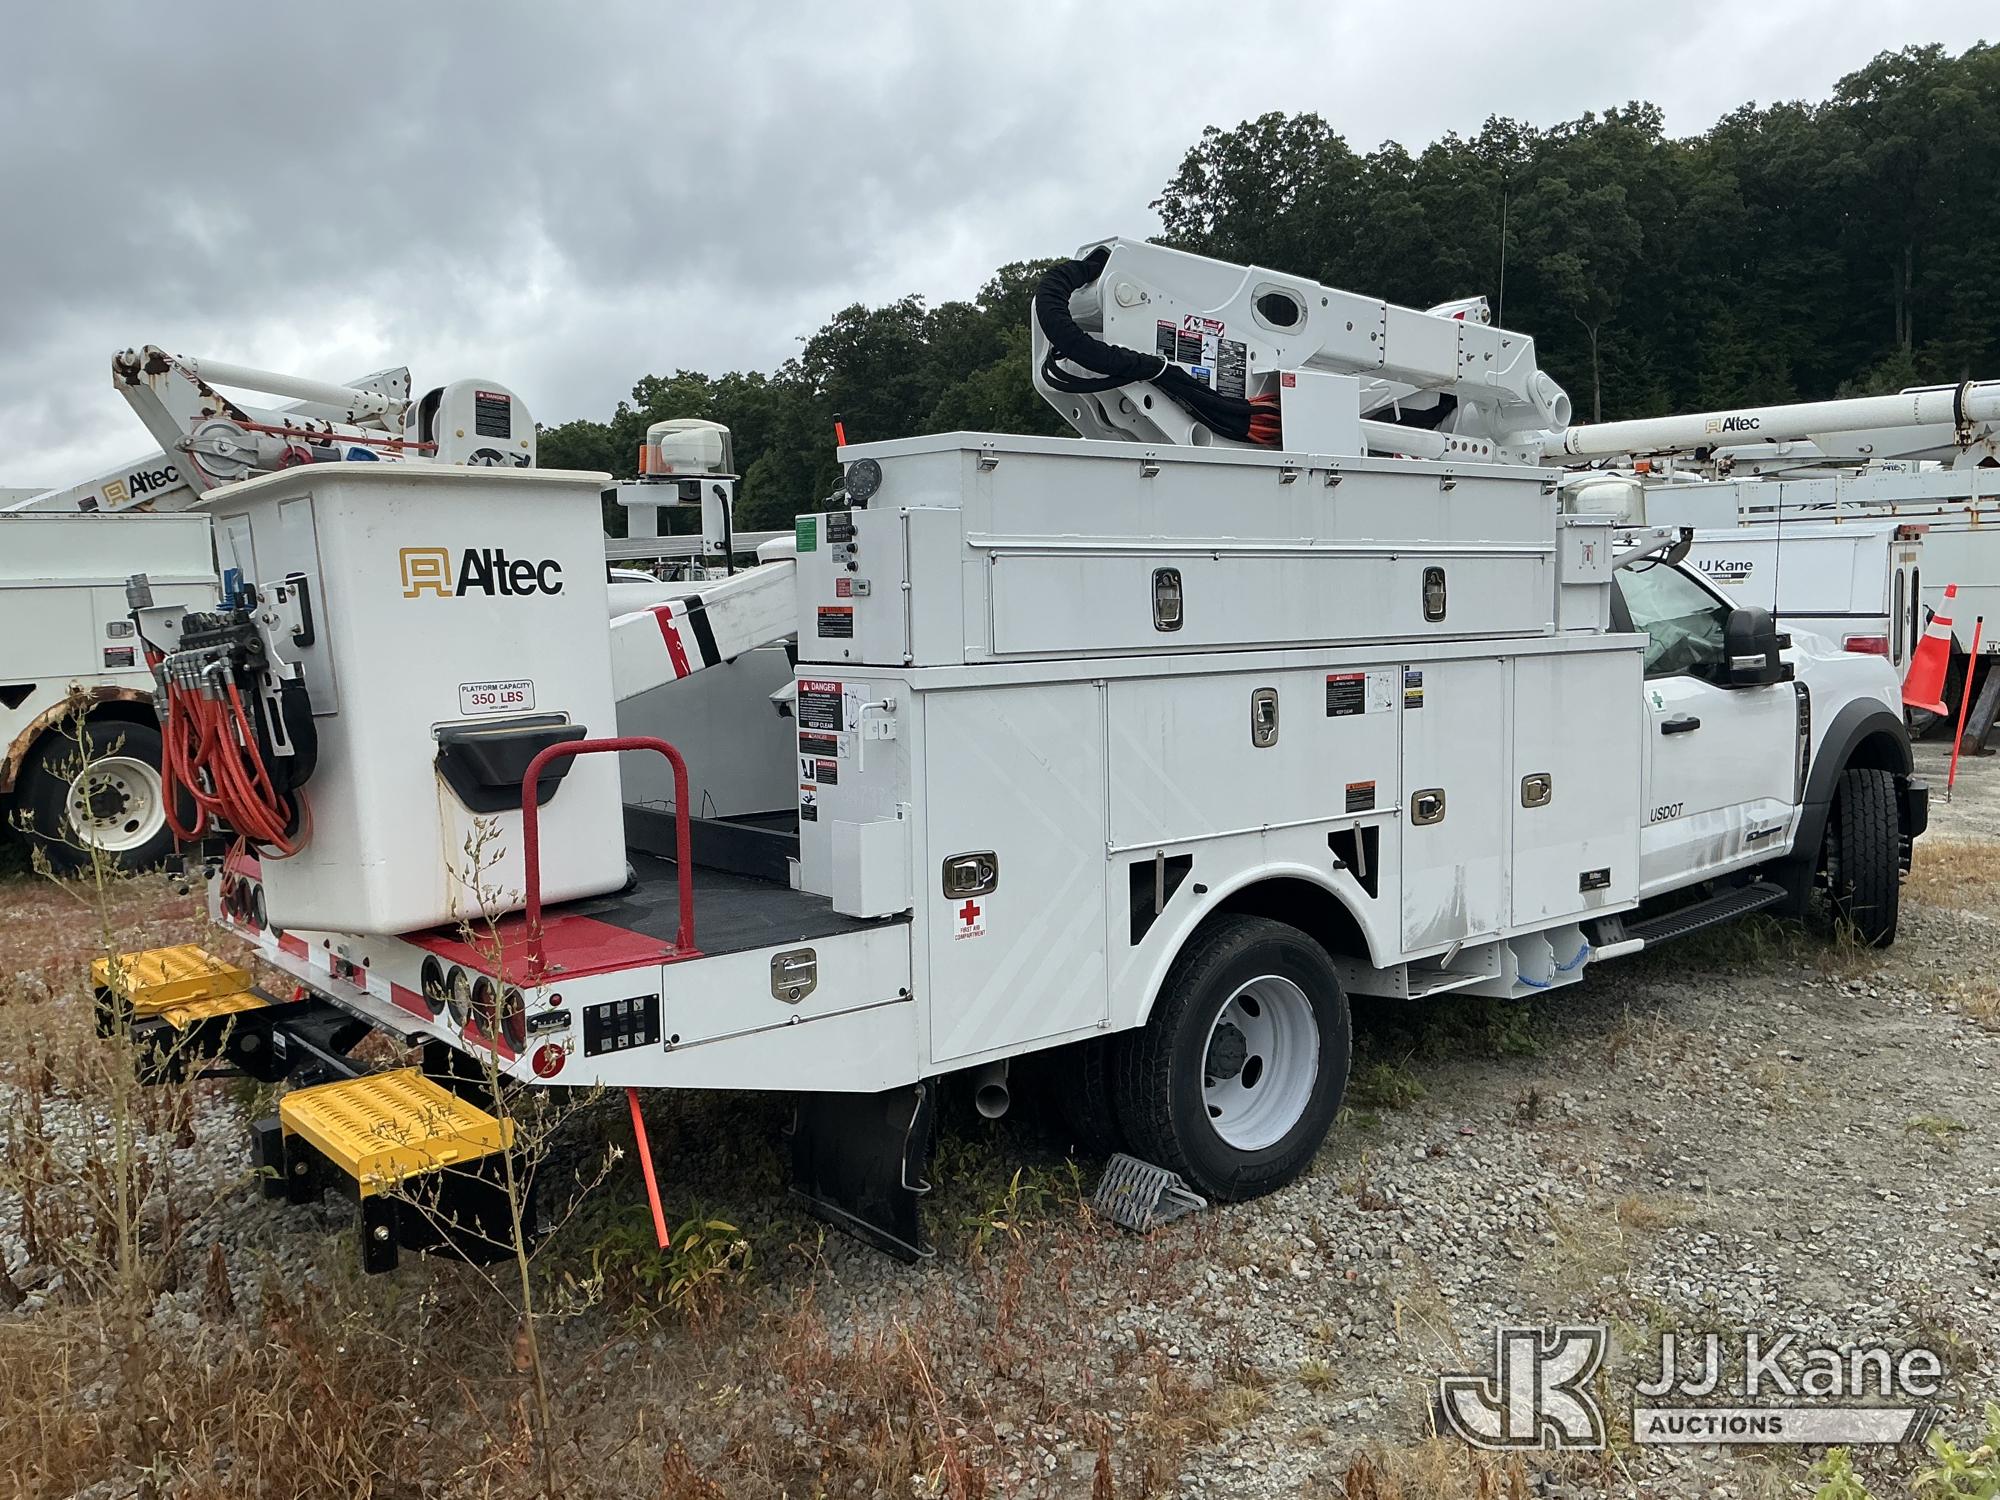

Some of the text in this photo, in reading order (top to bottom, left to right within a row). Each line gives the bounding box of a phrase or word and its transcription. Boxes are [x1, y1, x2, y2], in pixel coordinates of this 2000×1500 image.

[1722, 416, 1760, 432] Altec
[129, 465, 179, 498] Altec
[456, 548, 564, 597] Altec
[1715, 560, 1753, 571] Kane
[462, 682, 530, 693] PLATFORM CAPACITY
[811, 682, 836, 692] DANGER
[472, 691, 524, 705] 350 LBS
[1650, 803, 1683, 822] USDOT
[955, 930, 986, 941] COMPARTMENT
